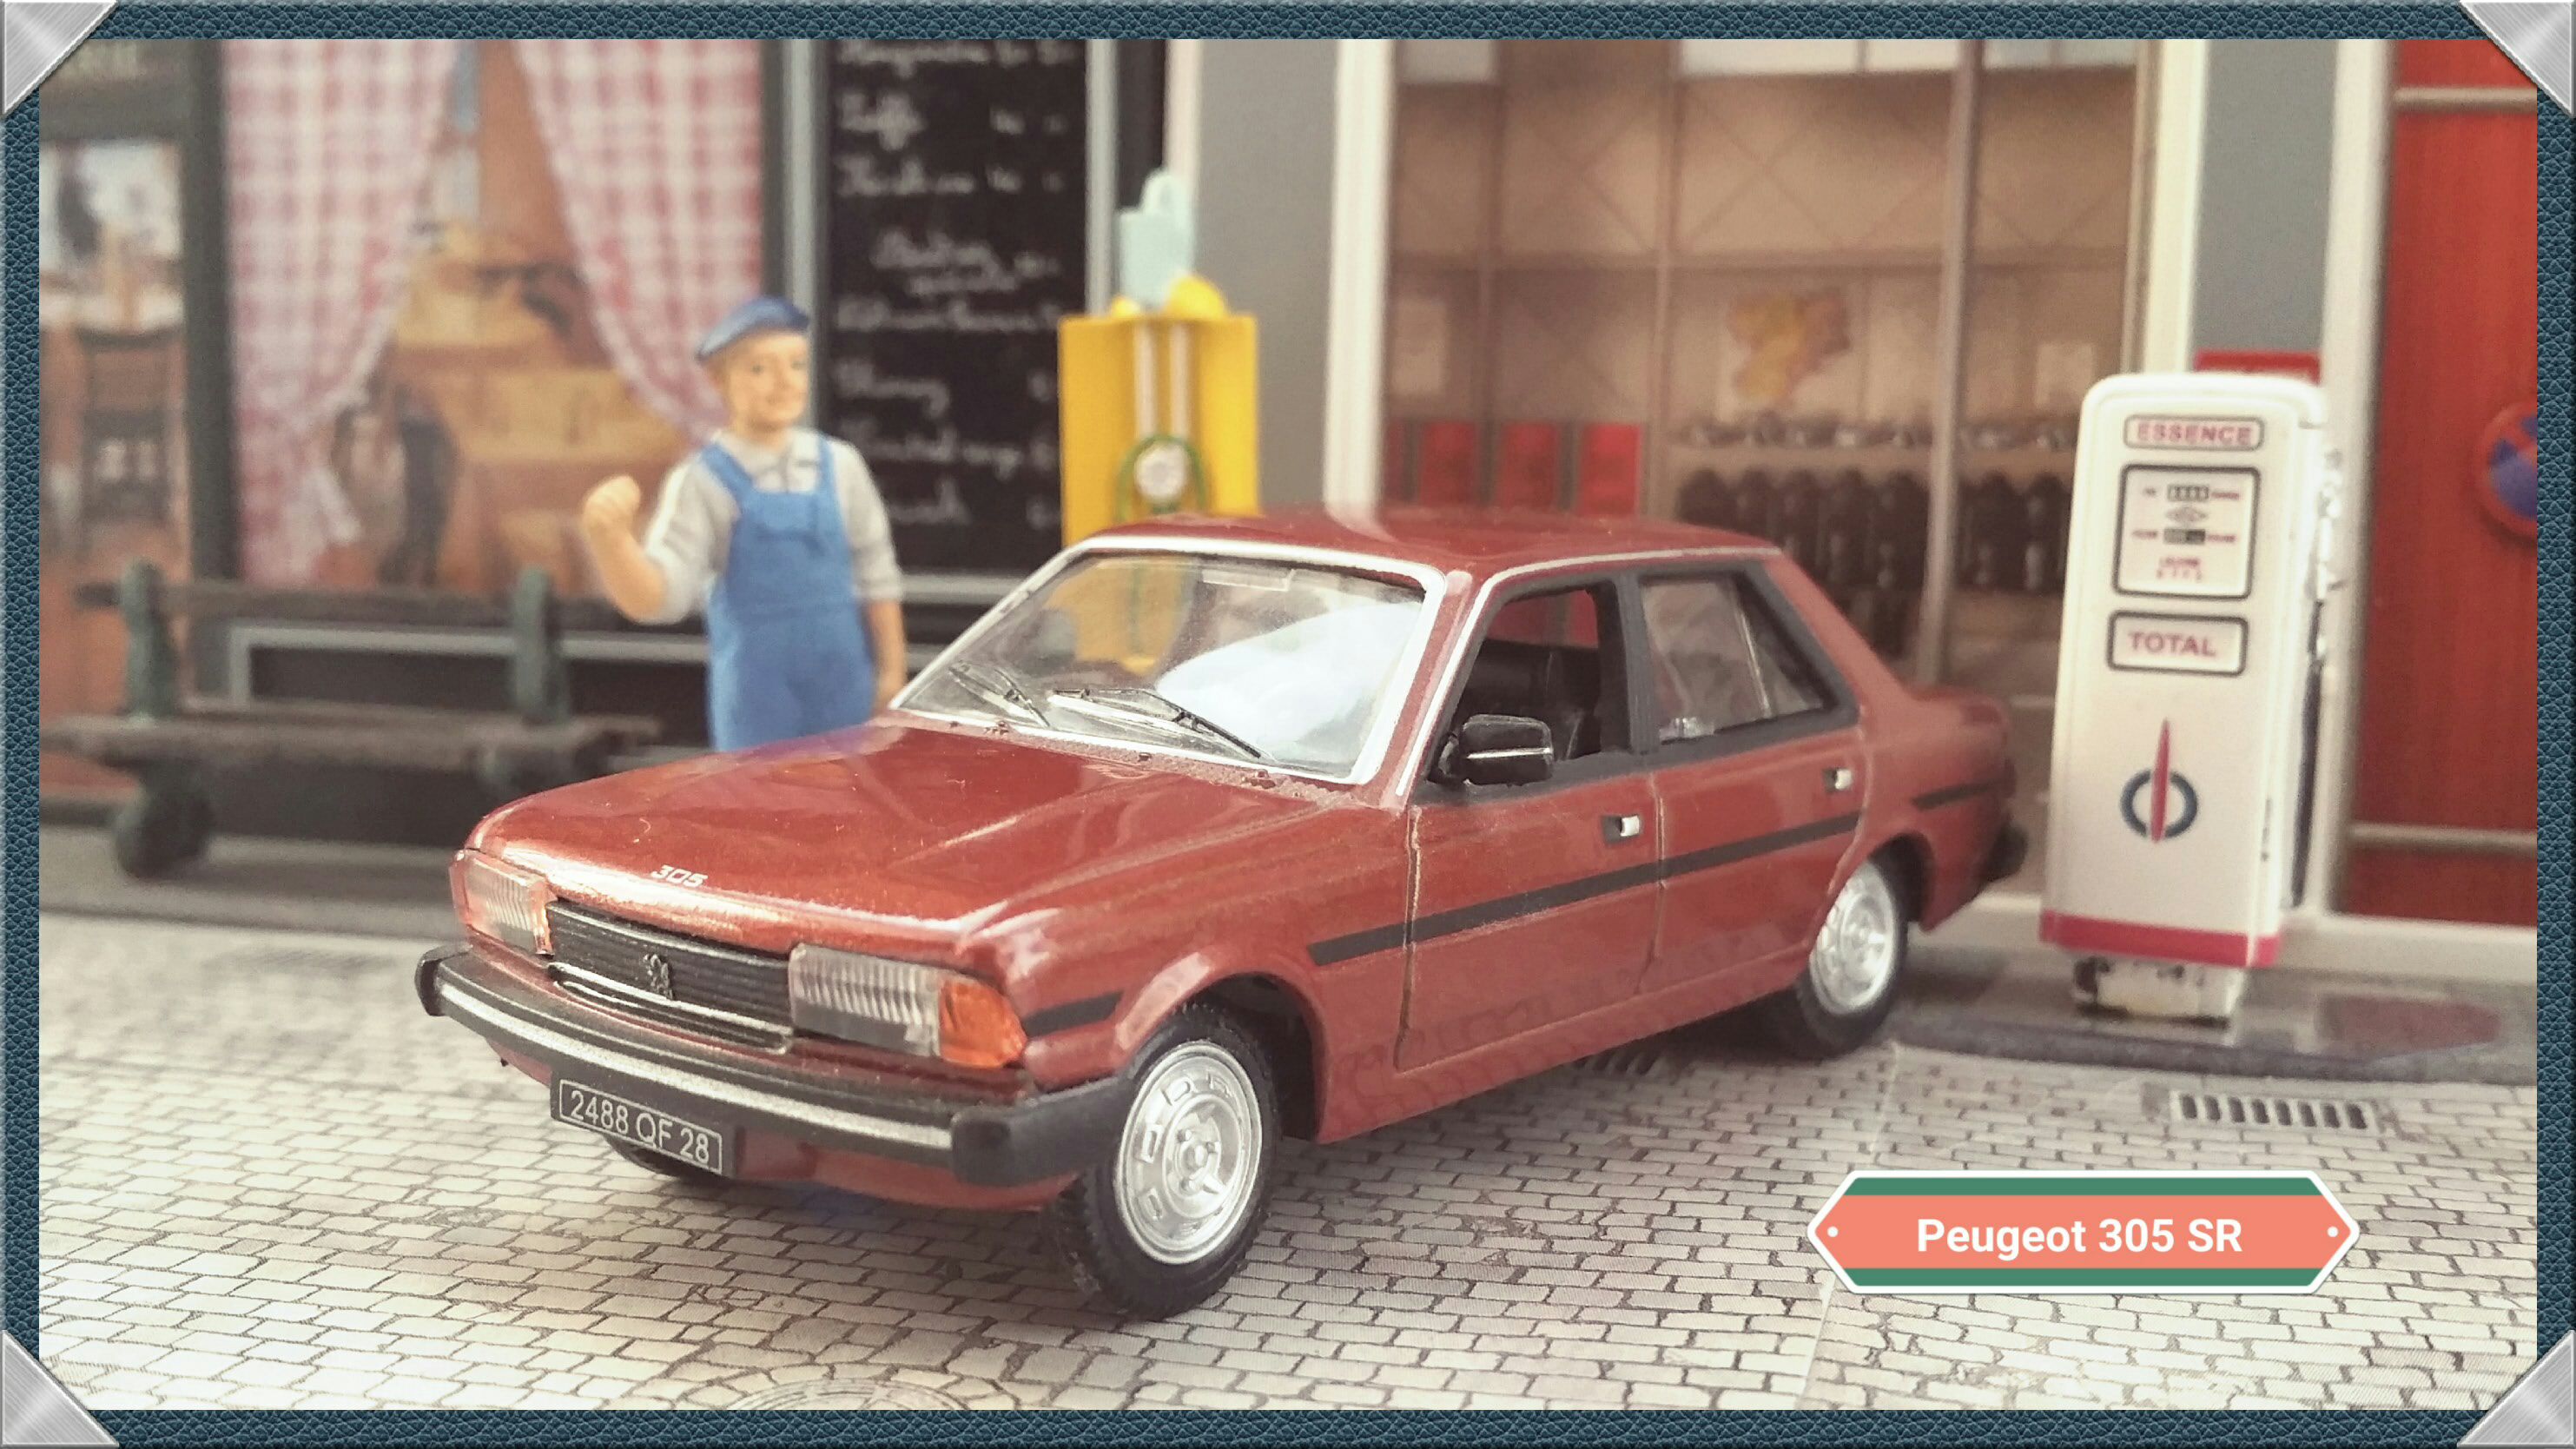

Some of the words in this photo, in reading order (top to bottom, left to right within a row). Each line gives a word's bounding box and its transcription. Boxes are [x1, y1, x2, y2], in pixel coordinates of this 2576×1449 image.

[2137, 421, 2252, 446] ESSENCE
[2130, 632, 2216, 658] TOTAL
[651, 864, 709, 887] 305
[571, 1090, 629, 1135] 2488
[636, 1113, 673, 1149] QF
[680, 1128, 710, 1164] 28
